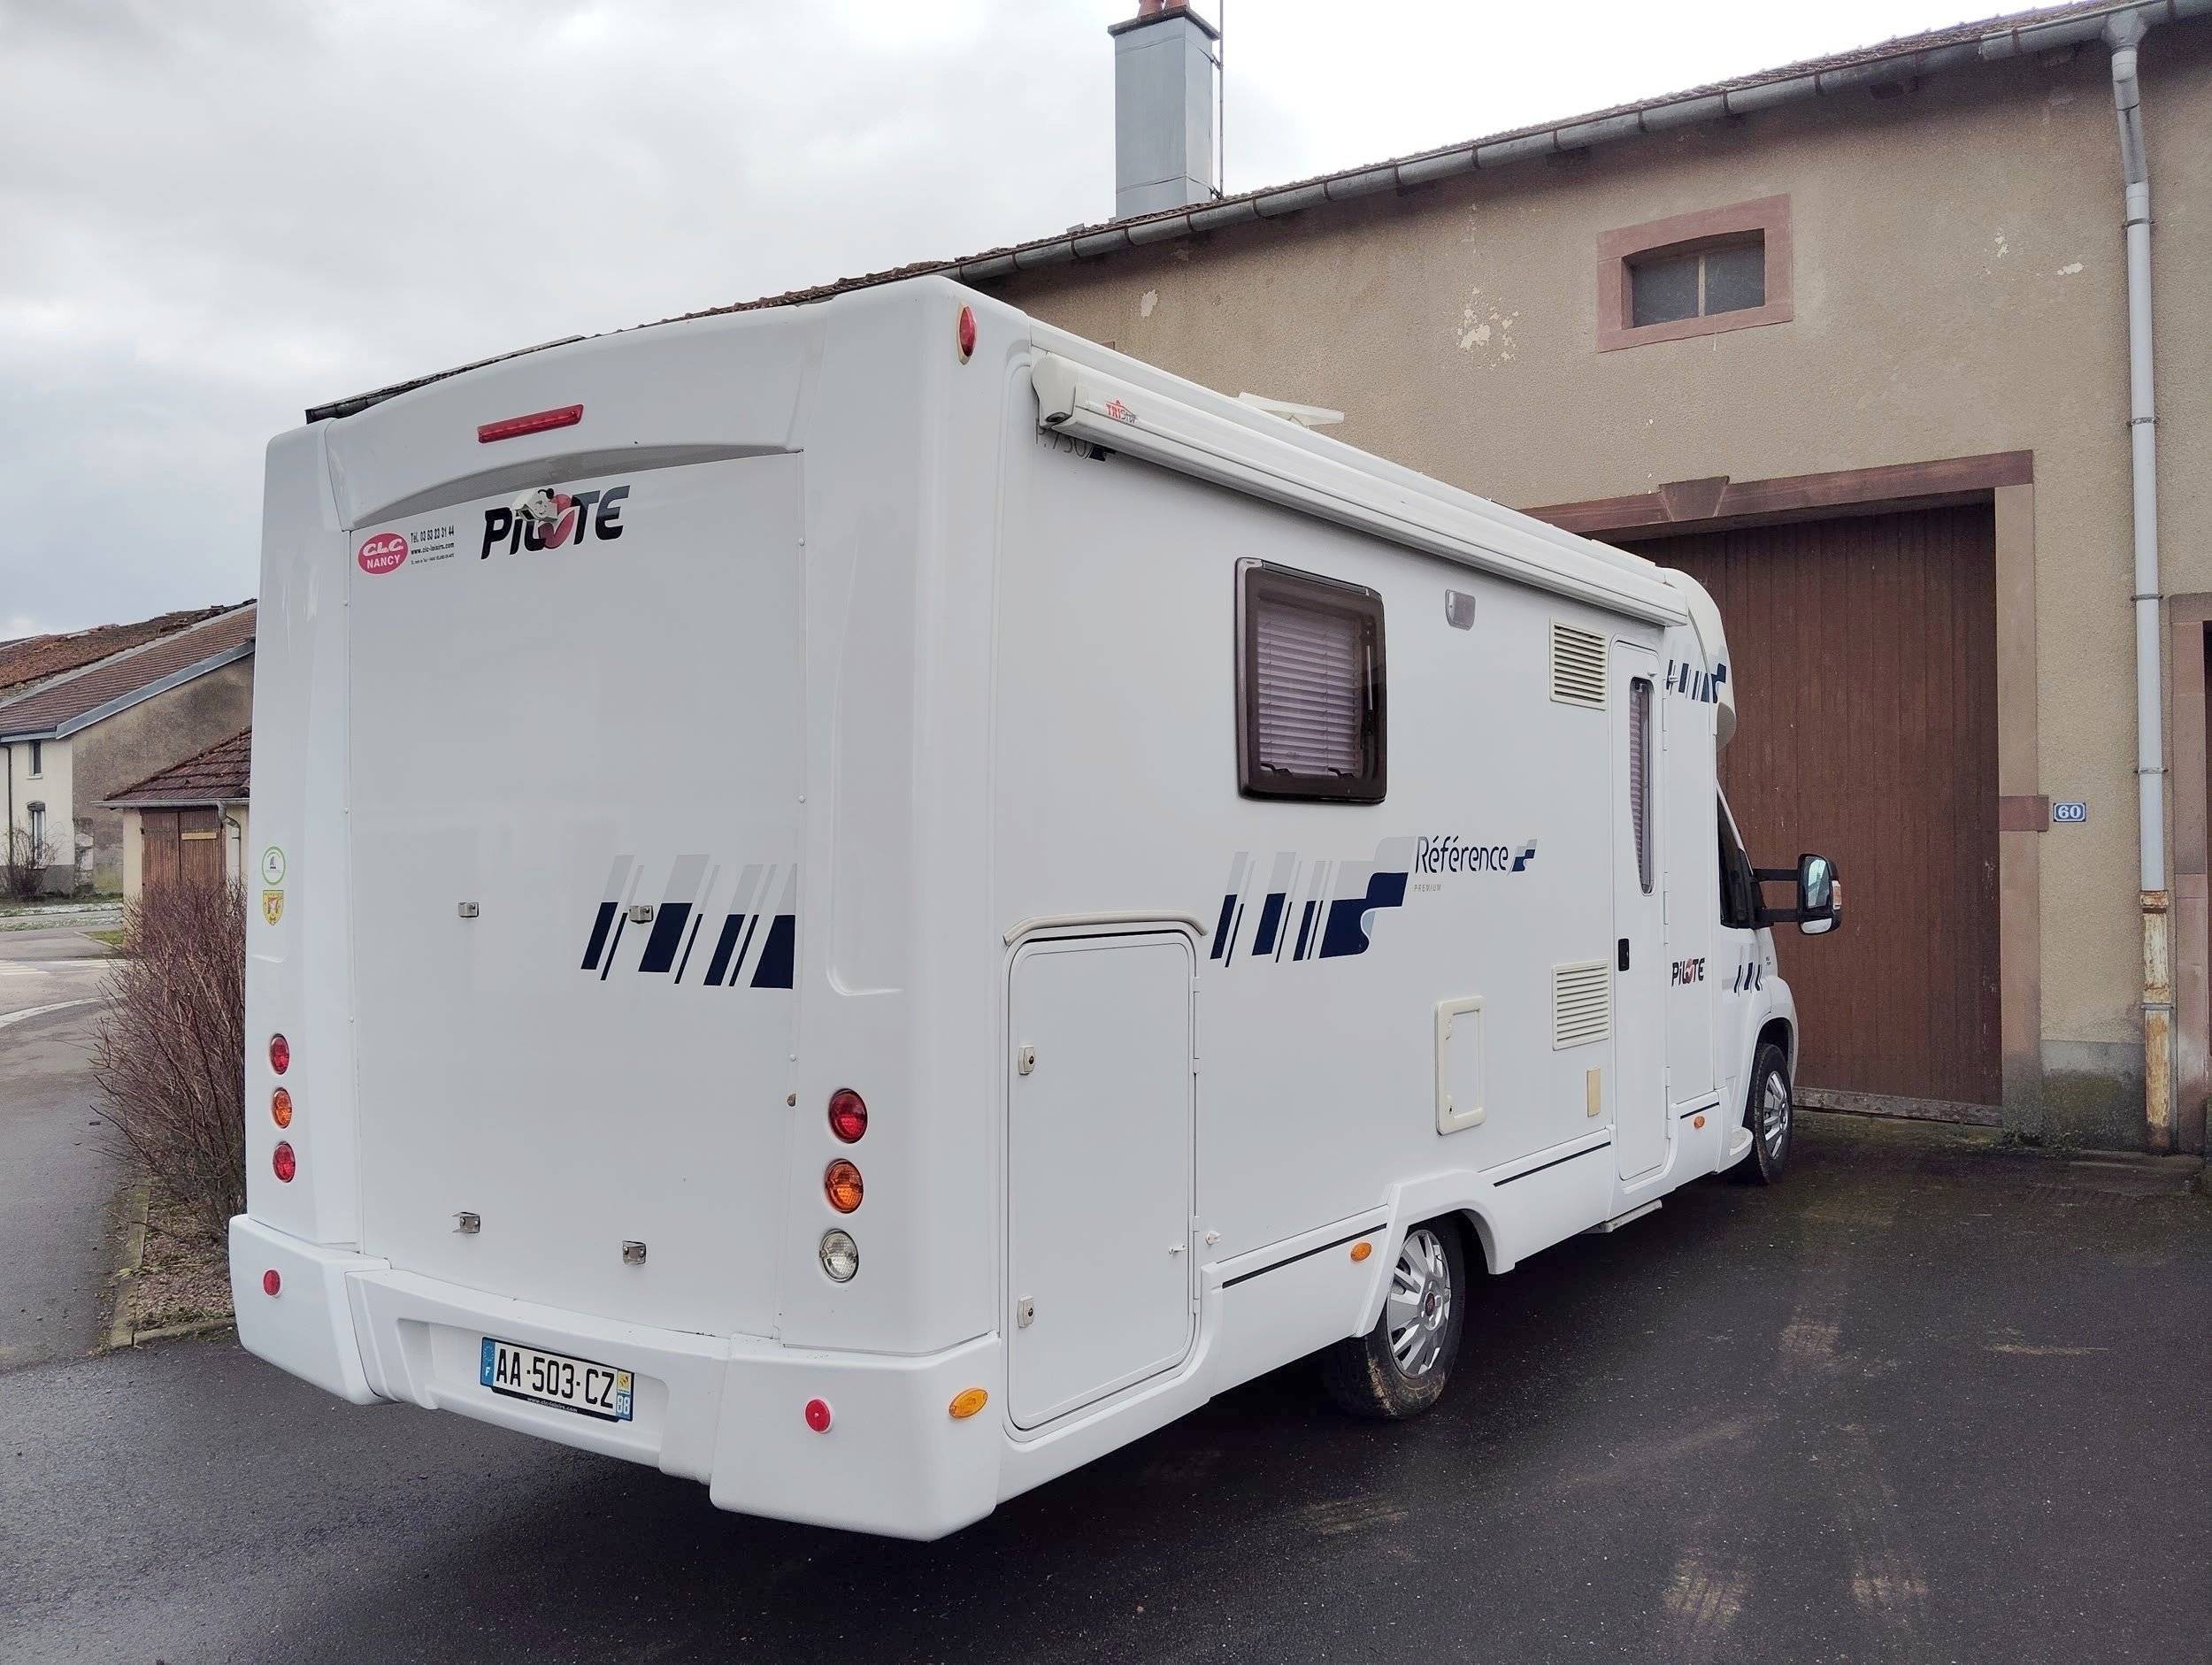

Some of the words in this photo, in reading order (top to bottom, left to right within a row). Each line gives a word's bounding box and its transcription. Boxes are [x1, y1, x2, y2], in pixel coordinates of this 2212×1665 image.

[362, 538, 404, 556] CLC
[366, 555, 401, 569] NANCY
[2057, 805, 2082, 819] 60
[1415, 835, 1509, 874] Référence
[616, 1394, 631, 1415] 88
